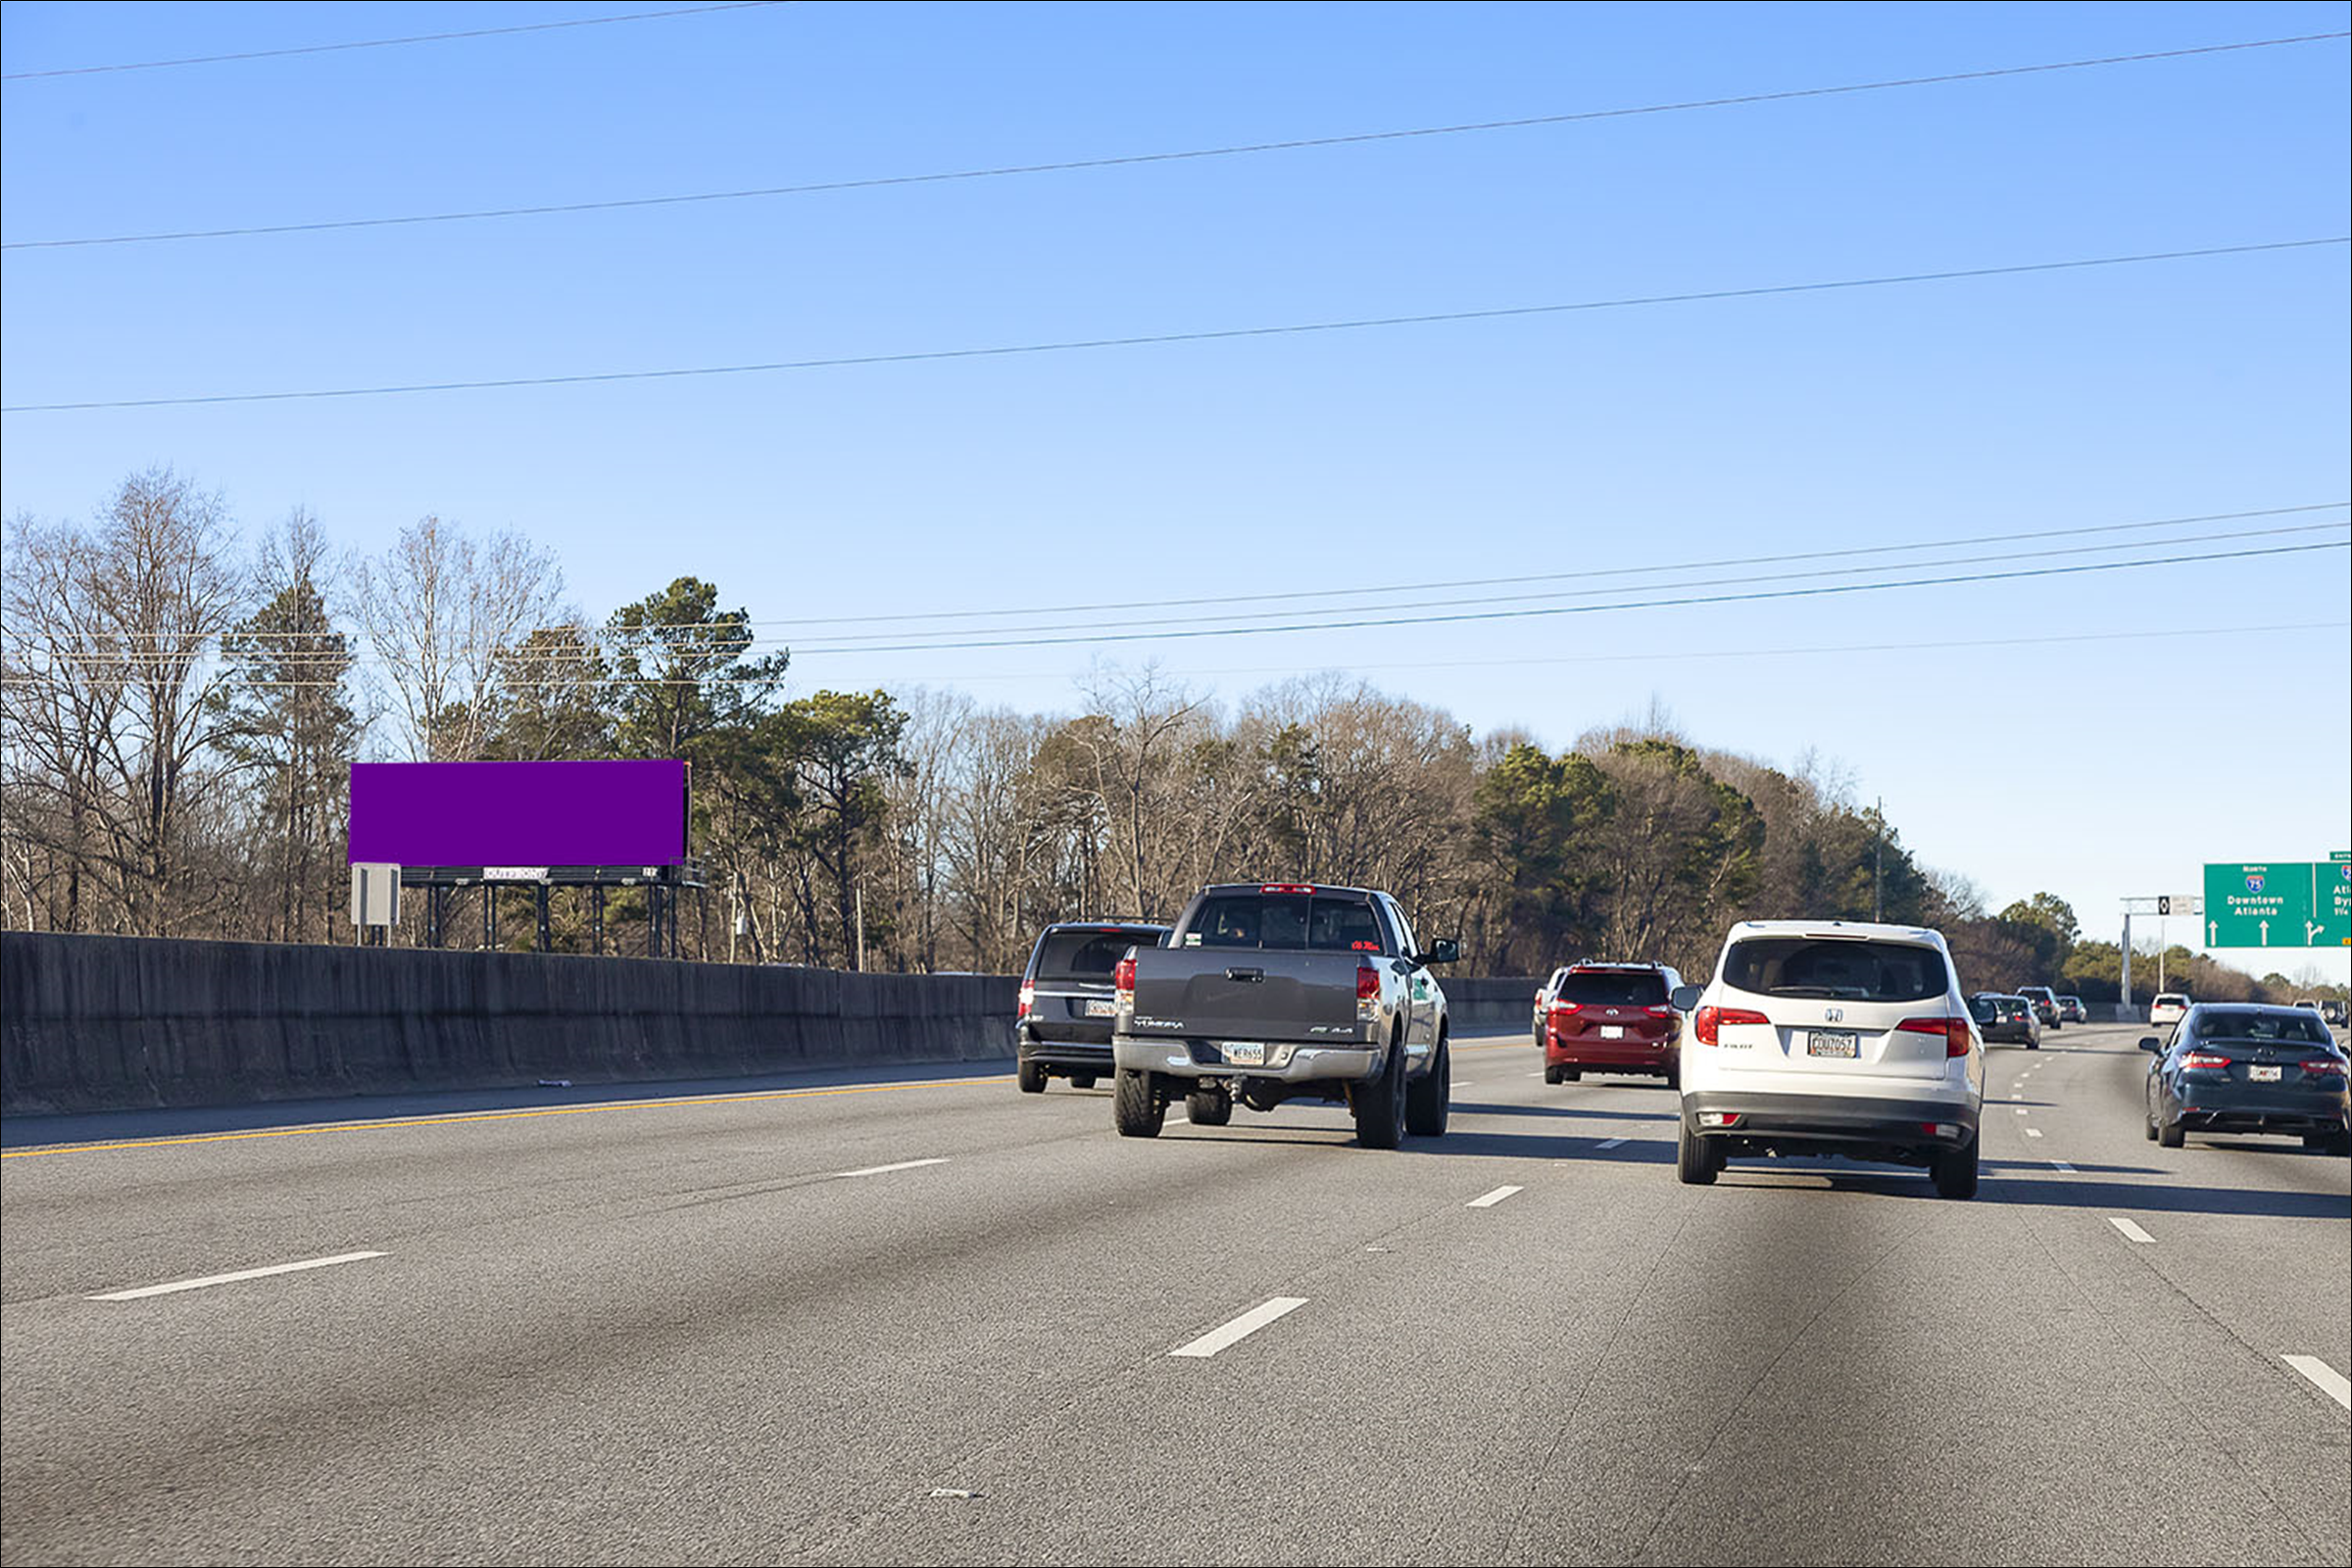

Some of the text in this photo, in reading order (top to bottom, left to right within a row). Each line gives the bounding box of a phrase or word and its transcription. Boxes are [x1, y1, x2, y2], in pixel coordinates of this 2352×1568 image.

[2250, 880, 2261, 889] 75
[2227, 896, 2283, 905] Downtown
[2234, 906, 2278, 915] Atlanta
